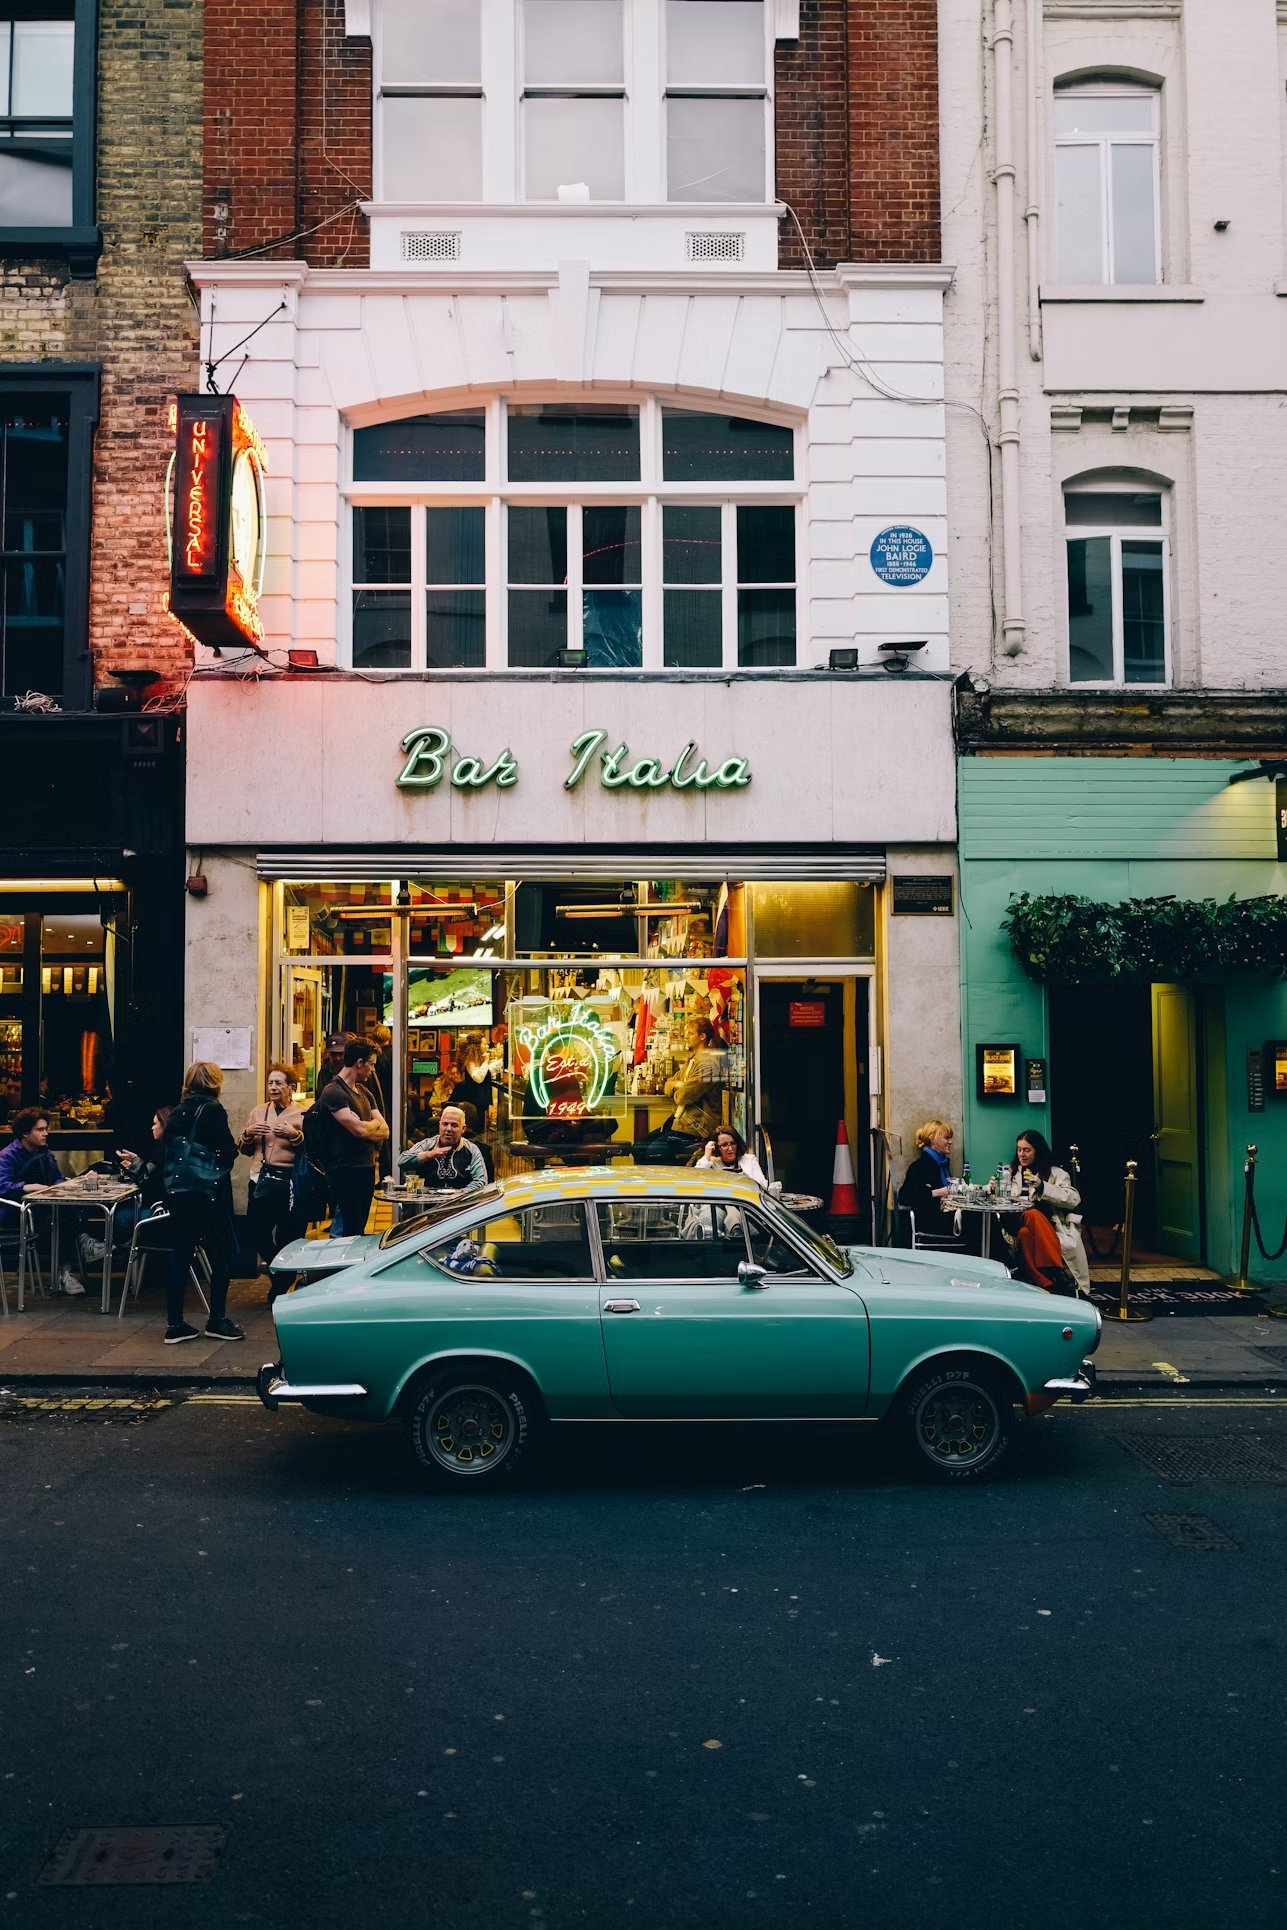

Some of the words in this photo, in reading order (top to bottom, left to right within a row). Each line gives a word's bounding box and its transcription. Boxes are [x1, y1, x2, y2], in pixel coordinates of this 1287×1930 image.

[186, 421, 207, 567] UNIVERSAL
[886, 552, 917, 561] BAIRD
[395, 725, 519, 788] Bar
[563, 728, 753, 790] Italia
[519, 1015, 561, 1052] Bar
[548, 1101, 589, 1116] 1949
[945, 1371, 970, 1380] P7F
[509, 1392, 528, 1444] PIRELLI
